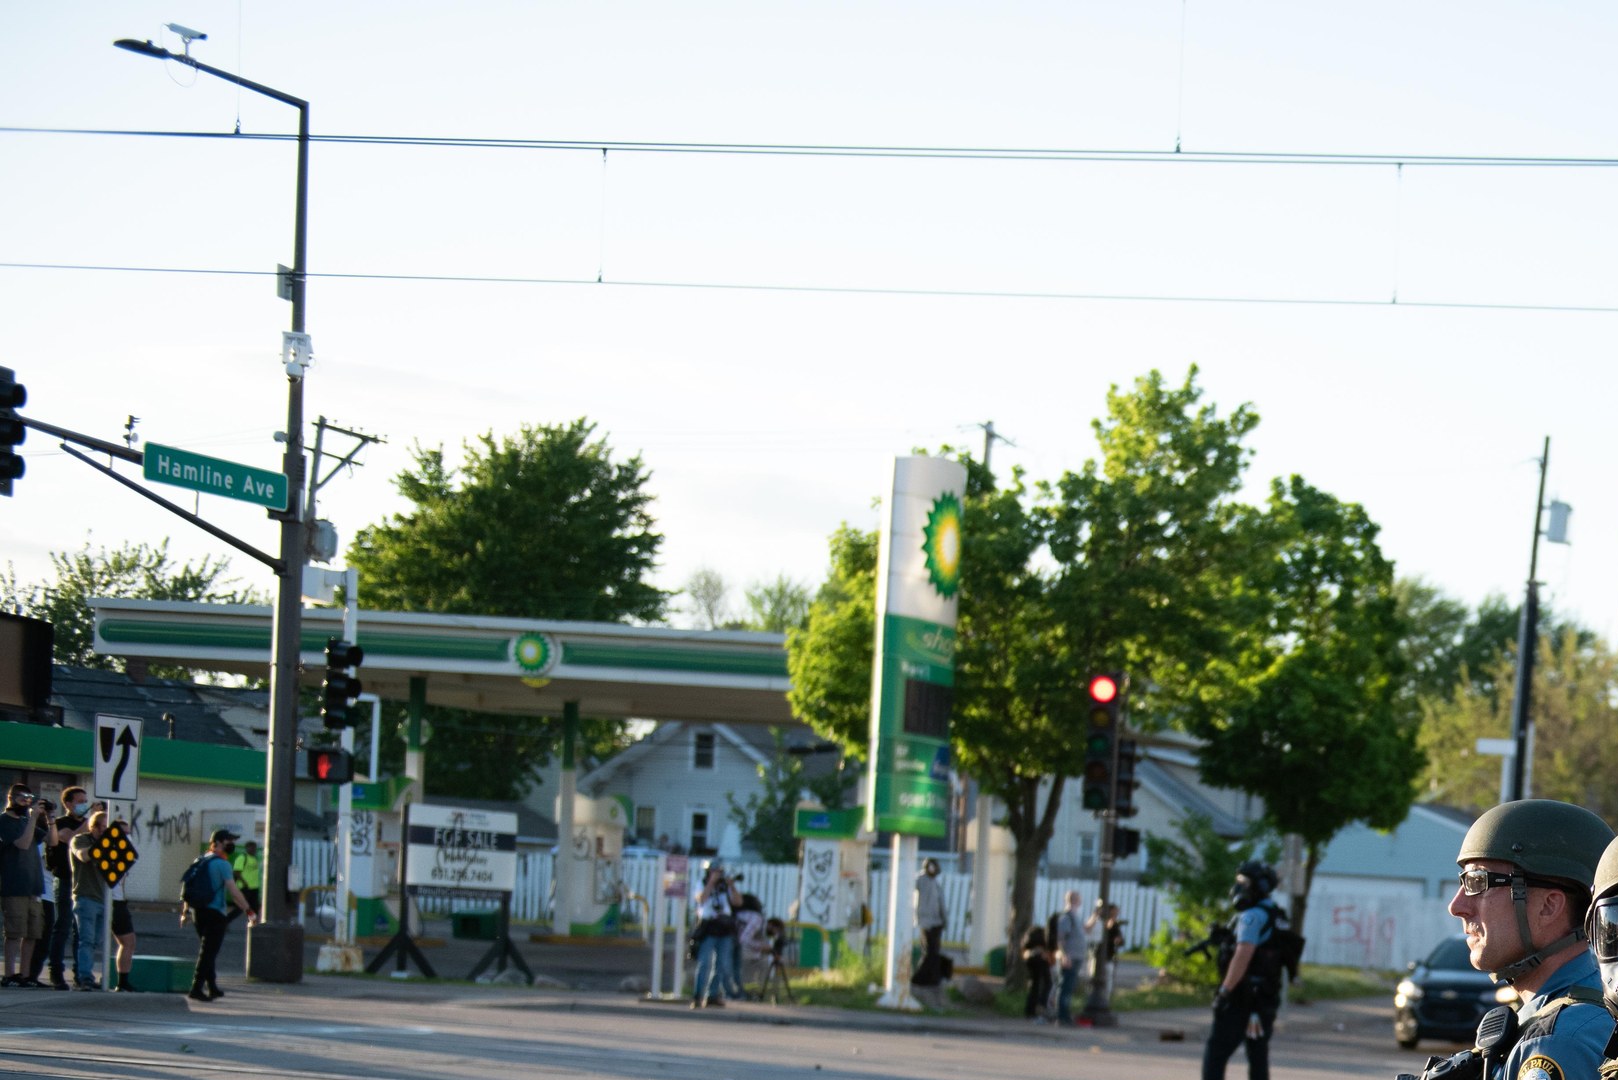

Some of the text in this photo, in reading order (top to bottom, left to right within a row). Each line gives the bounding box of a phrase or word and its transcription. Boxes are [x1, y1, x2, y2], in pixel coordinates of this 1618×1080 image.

[158, 454, 275, 499] Hamline Ave
[467, 829, 497, 851] SALE
[1530, 1058, 1555, 1075] PAUL
